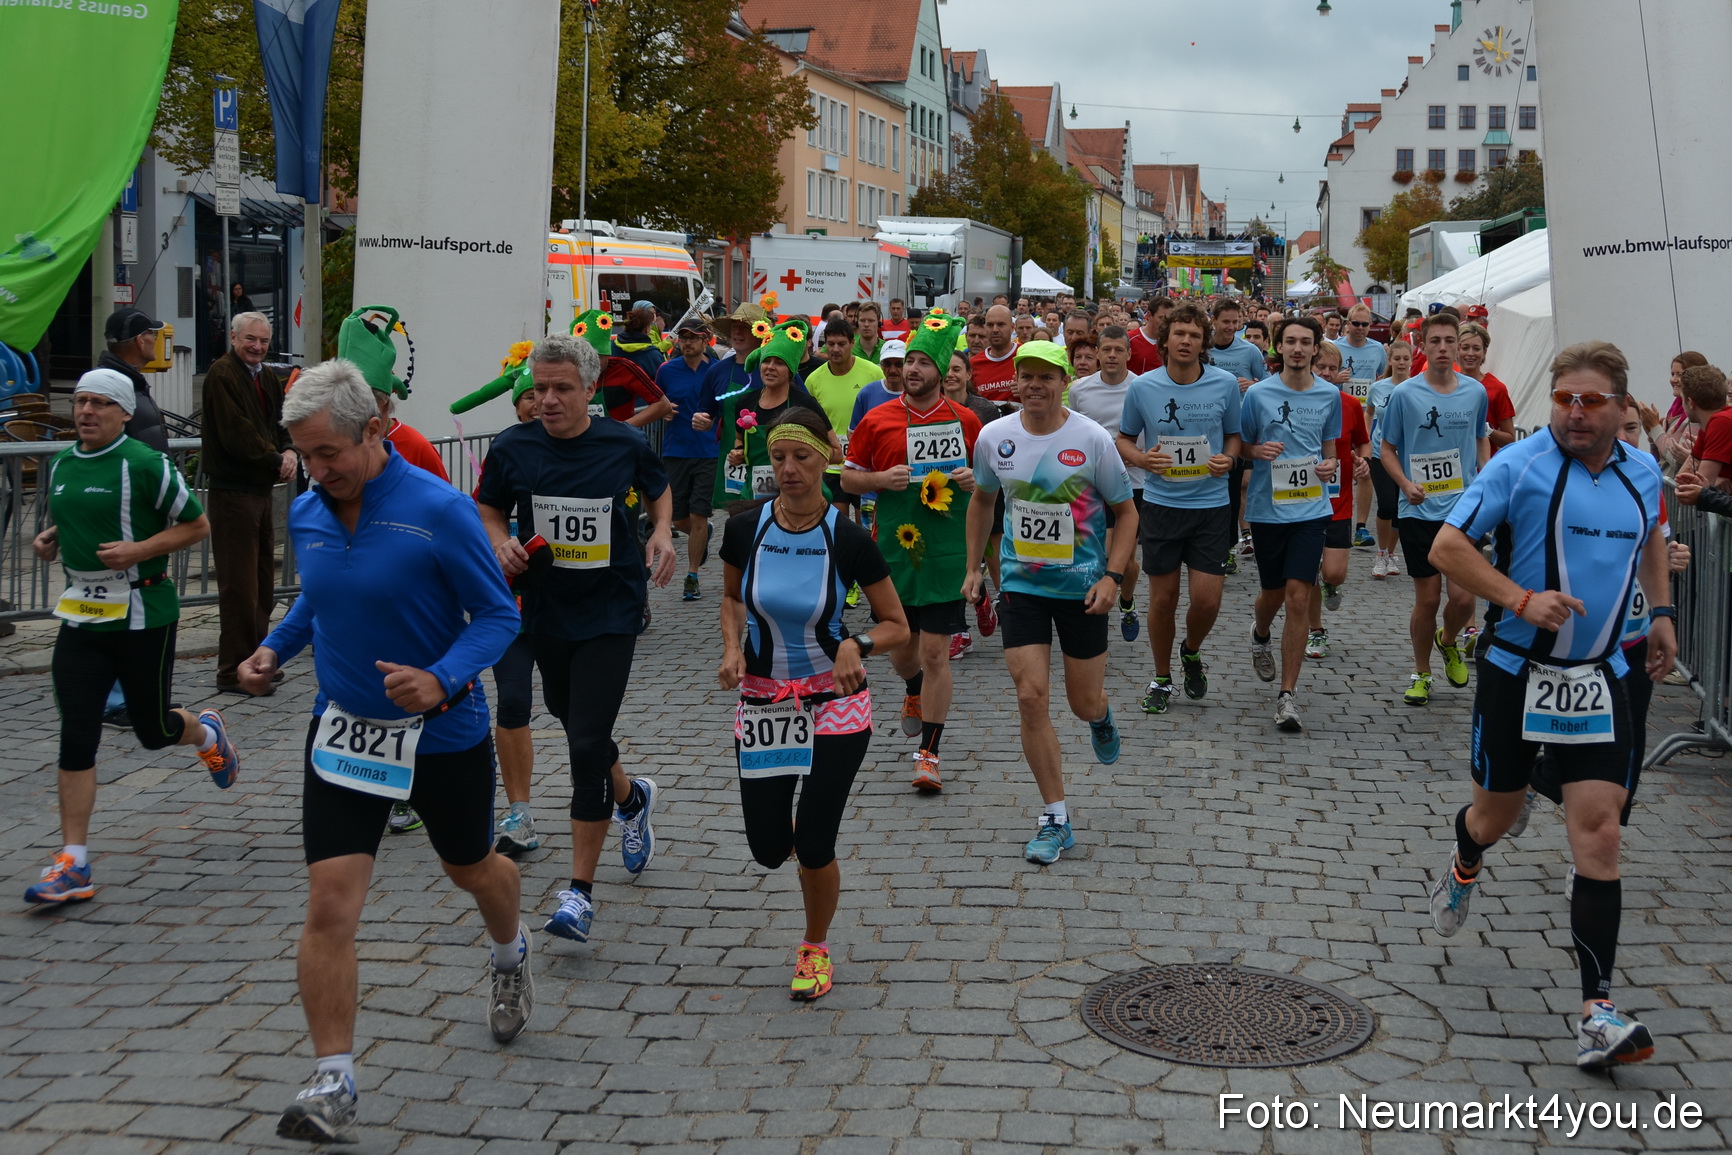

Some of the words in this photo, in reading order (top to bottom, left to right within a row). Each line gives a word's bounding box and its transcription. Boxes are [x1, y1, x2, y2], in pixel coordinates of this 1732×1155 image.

[161, 231, 169, 250] 3
[359, 234, 513, 254] www.bmw-laufsport.de
[1194, 258, 1225, 266] START
[805, 269, 847, 278] Bayerisches
[1023, 287, 1051, 295] Laufsport
[1349, 385, 1368, 396] 183
[1183, 403, 1201, 411] GYM
[1296, 407, 1314, 415] GYM
[1444, 411, 1461, 419] GYM
[929, 429, 954, 437] Neumarkt
[914, 437, 961, 460] 2423
[1062, 452, 1084, 463] Hervis
[1175, 448, 1196, 464] 14
[1170, 468, 1200, 476] Matthias
[1422, 461, 1453, 480] 150
[1289, 469, 1308, 487] 49
[1428, 483, 1449, 491] Stefan
[534, 502, 559, 512] PARTL
[561, 505, 599, 513] Neumarkt
[1013, 503, 1029, 514] PARTL
[1031, 509, 1062, 517] Neumarkt
[549, 515, 597, 542] 195
[1020, 516, 1061, 541] 524
[555, 547, 588, 559] Stefan
[80, 603, 104, 616] Steve
[1531, 667, 1558, 679] PARTL
[1535, 680, 1604, 712] 2022
[743, 715, 809, 748] 3073
[1551, 719, 1589, 732] Robert
[327, 716, 407, 760] 2821
[743, 751, 808, 767] BARBARA
[336, 758, 388, 783] Thomas
